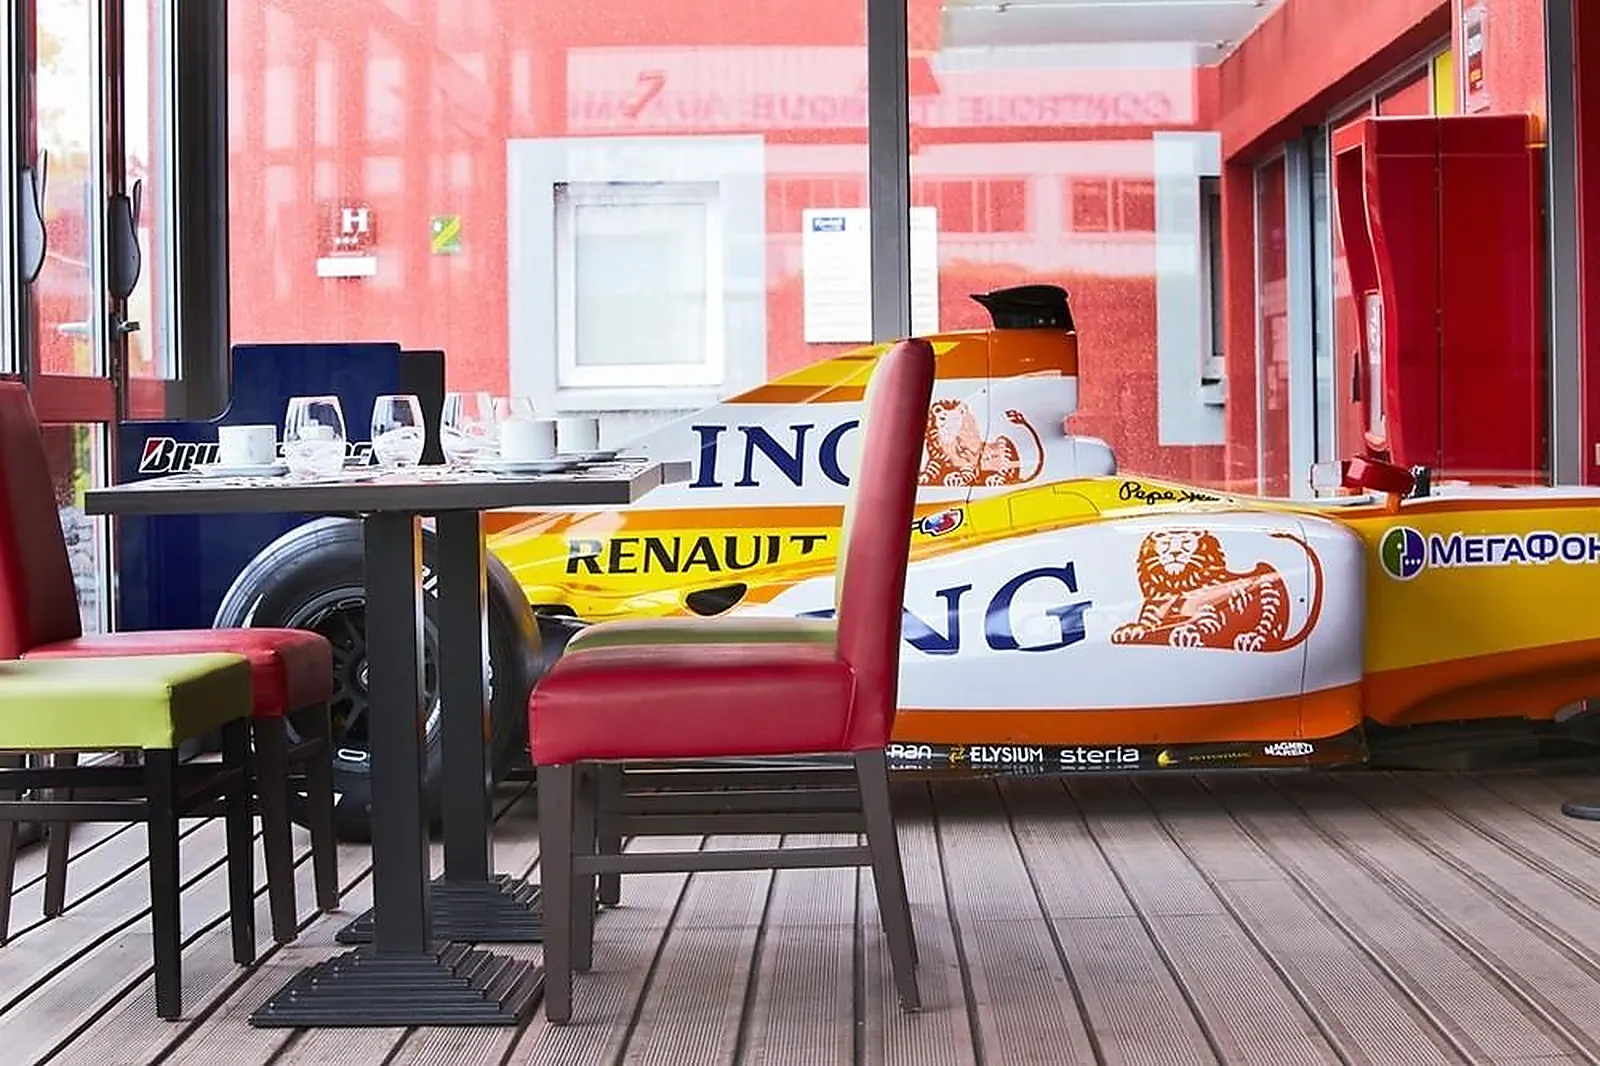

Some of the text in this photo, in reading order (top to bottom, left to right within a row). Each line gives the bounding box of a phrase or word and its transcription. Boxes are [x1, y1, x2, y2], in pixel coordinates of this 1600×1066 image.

[341, 207, 369, 233] H
[969, 746, 1043, 763] ELYSIUM
[1060, 746, 1140, 764] steria
